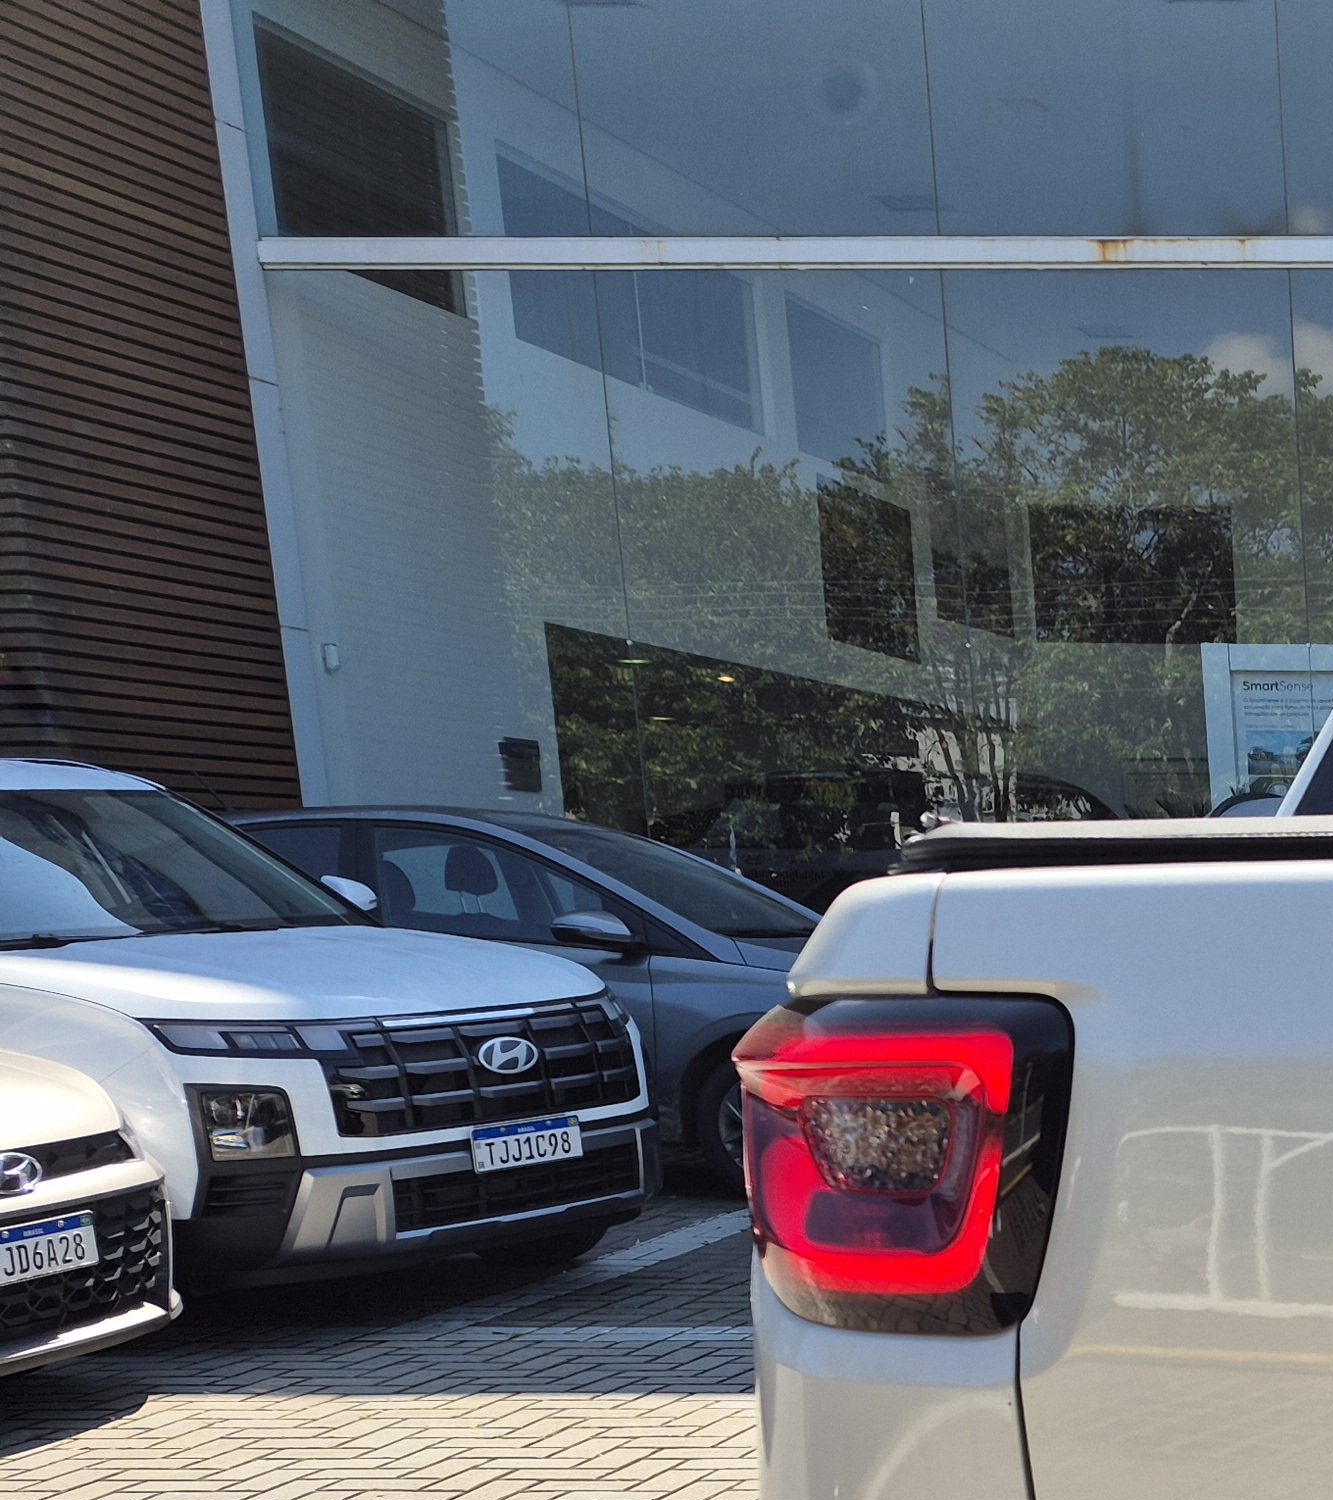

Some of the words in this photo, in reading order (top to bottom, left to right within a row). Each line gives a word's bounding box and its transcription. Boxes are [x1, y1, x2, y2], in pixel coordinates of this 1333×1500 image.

[1242, 681, 1313, 692] SmartSense
[484, 1131, 572, 1166] TJJ1C98
[3, 1233, 86, 1277] JD6A28
